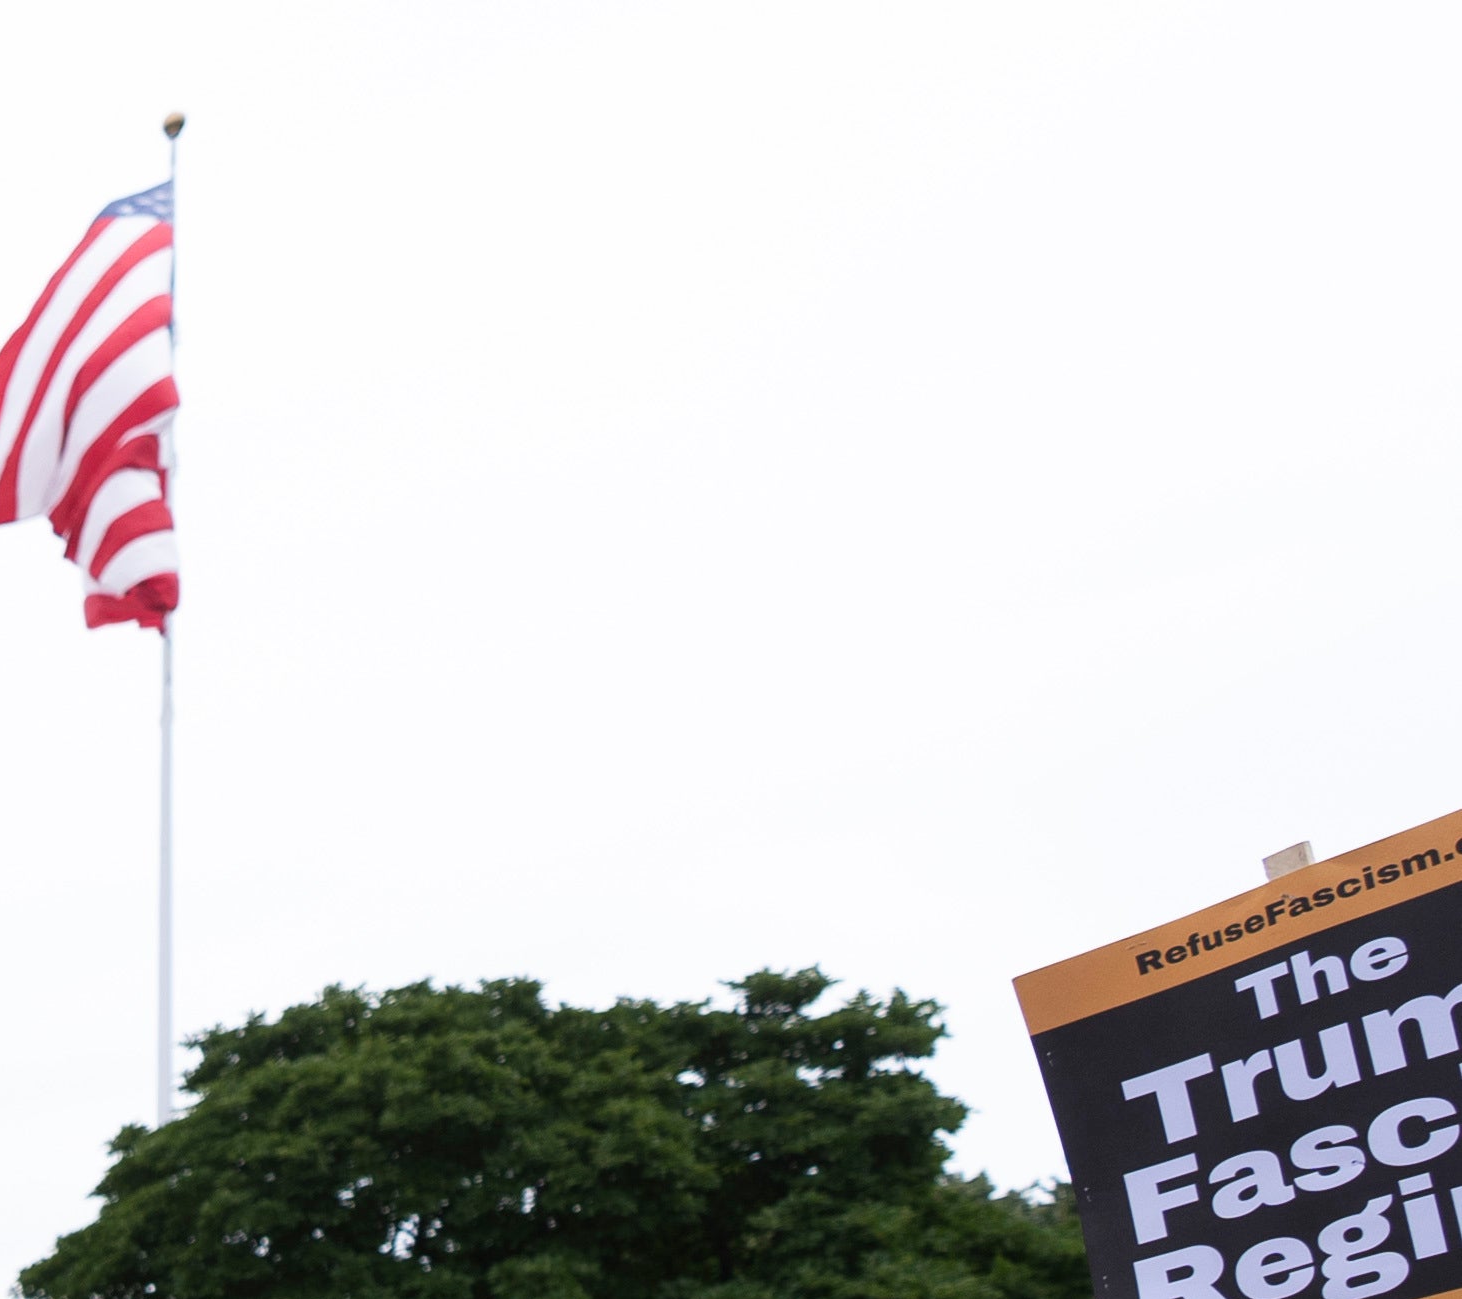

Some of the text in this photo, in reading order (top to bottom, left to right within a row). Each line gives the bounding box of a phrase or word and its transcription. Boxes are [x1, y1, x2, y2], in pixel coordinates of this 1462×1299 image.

[1235, 935, 1410, 1022] The
[1121, 983, 1462, 1145] Trum
[1123, 1063, 1462, 1245] Fasc
